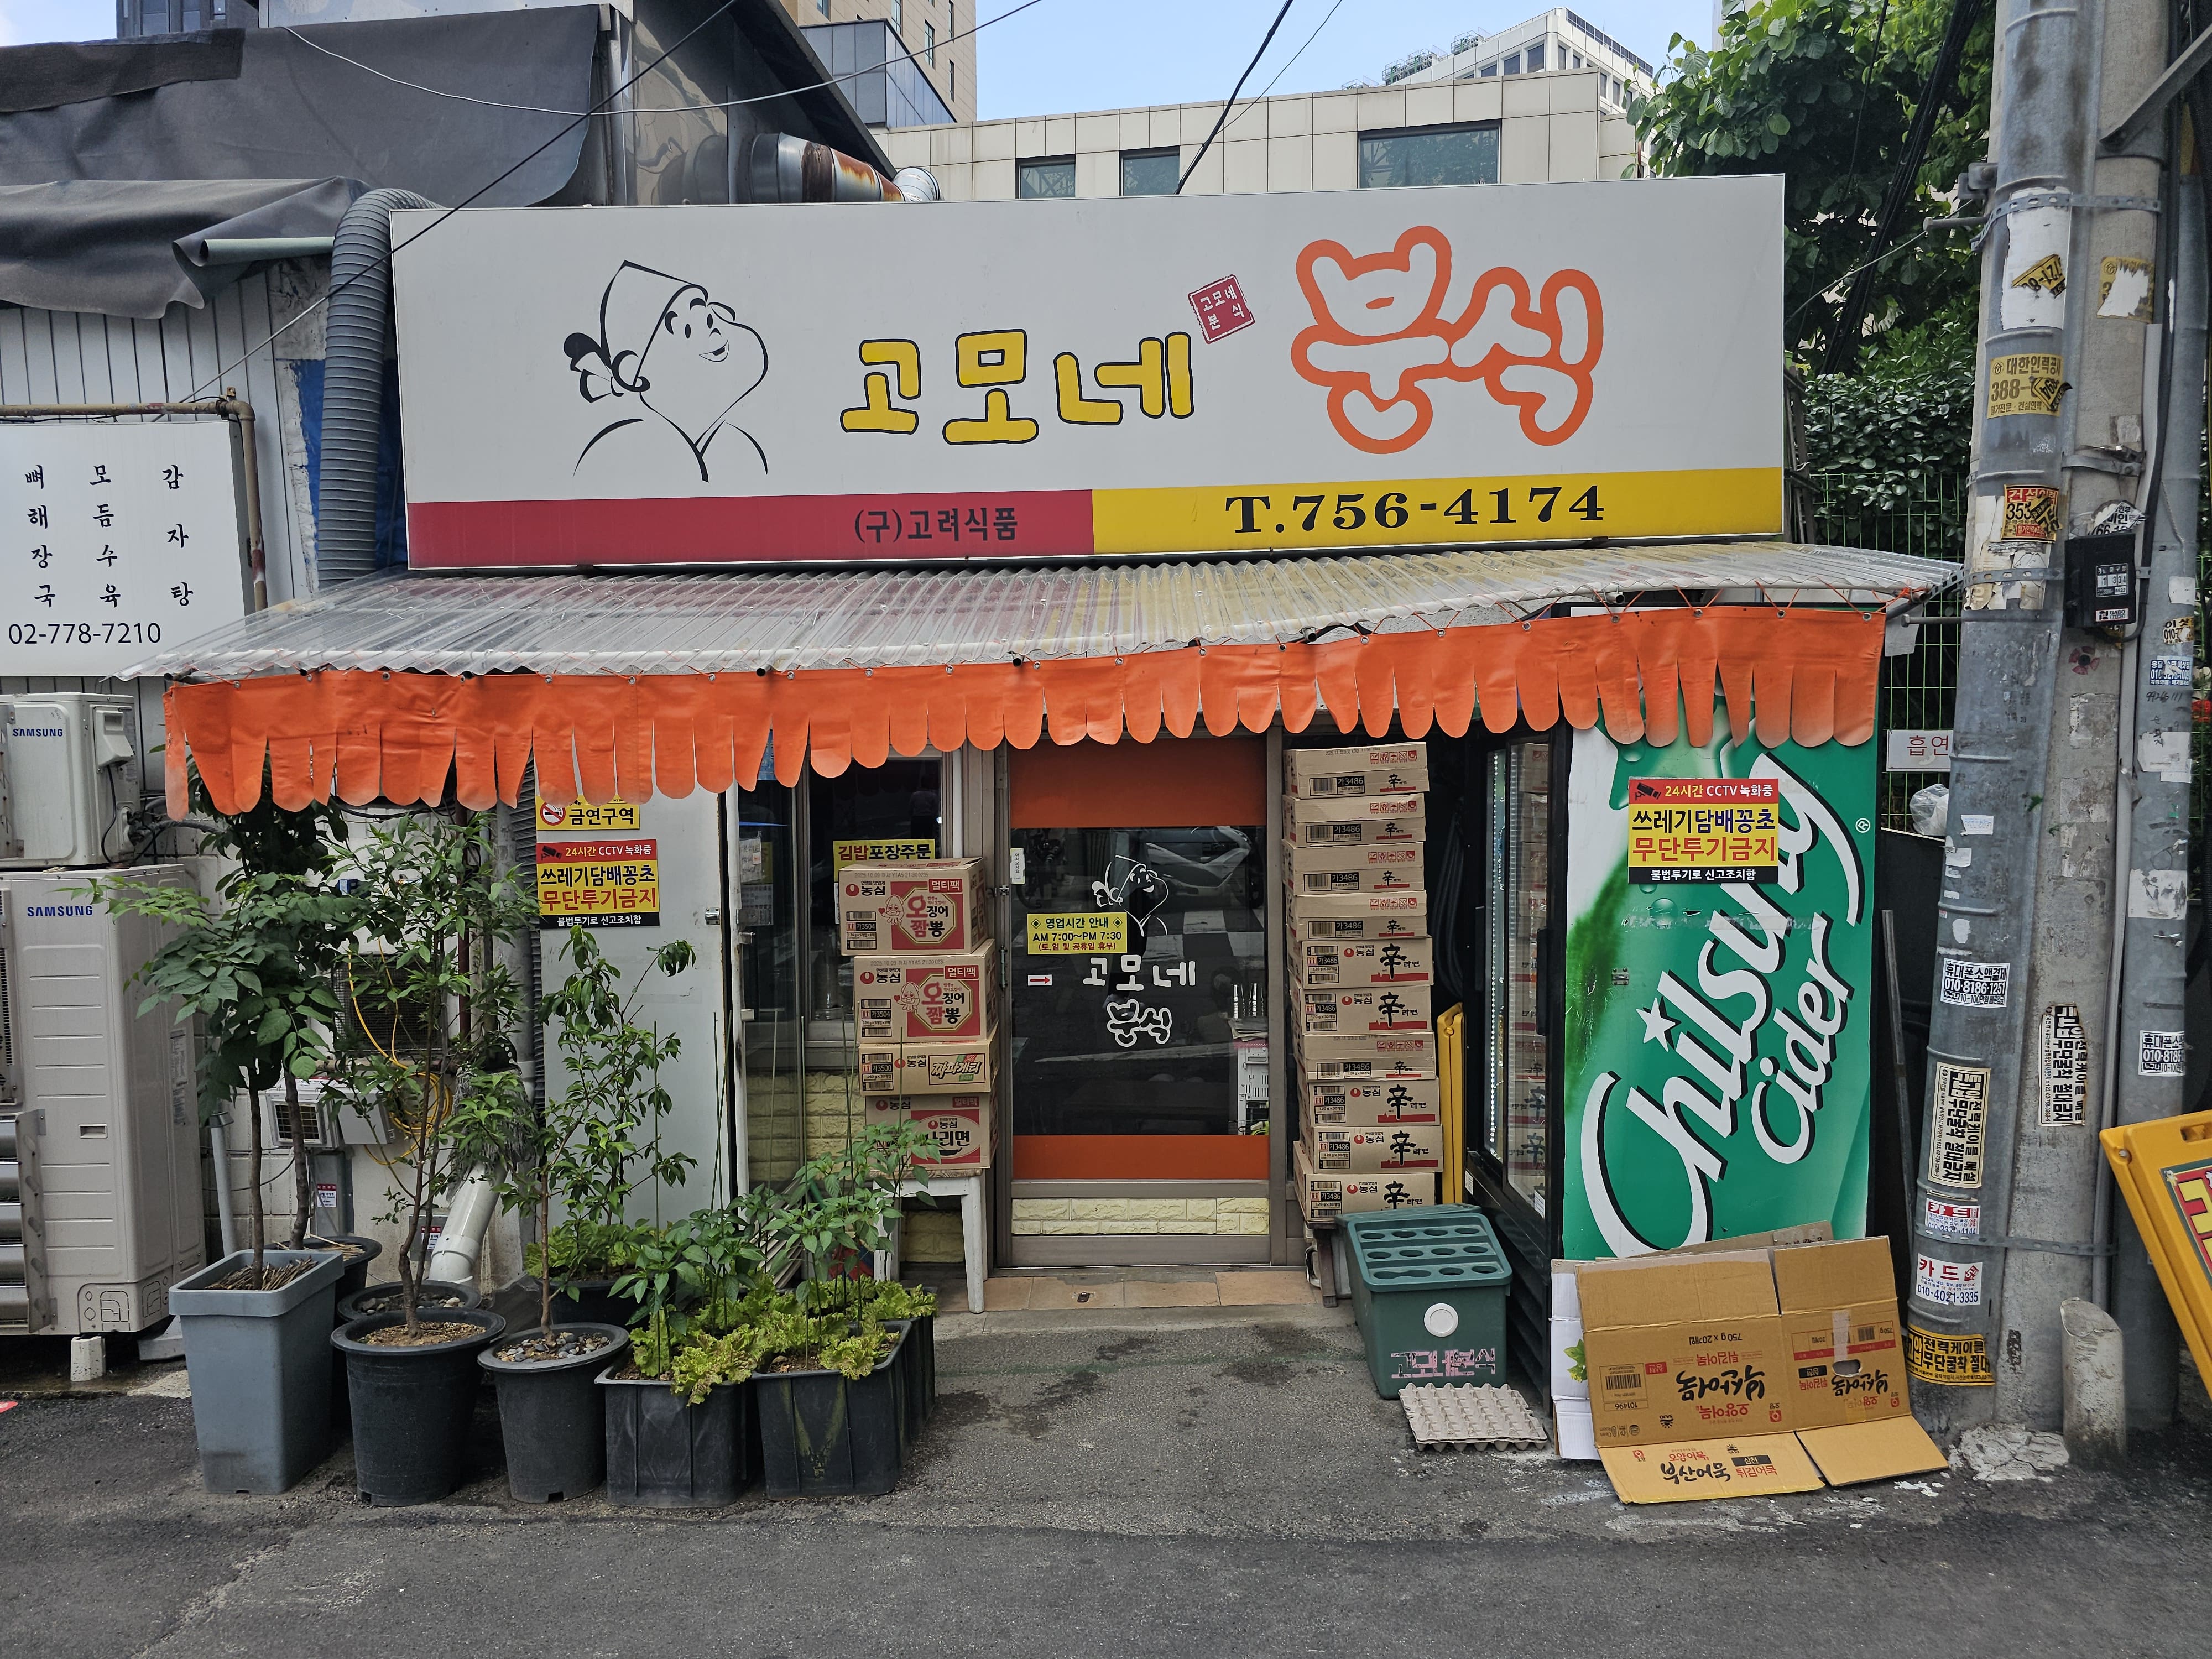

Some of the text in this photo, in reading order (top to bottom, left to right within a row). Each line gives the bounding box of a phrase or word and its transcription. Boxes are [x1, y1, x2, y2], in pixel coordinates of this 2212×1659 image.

[1200, 284, 1237, 311] 고모네
[1291, 225, 1604, 454] 분식
[840, 329, 1195, 445] 고모네
[1225, 485, 1604, 534] T.756-4174
[163, 465, 194, 607] 감자탕
[854, 507, 1018, 544] (구)고려식품
[25, 465, 55, 608] 뼈해장국
[90, 465, 121, 608] 모듬수육
[8, 622, 161, 644] 02-778-7210
[13, 728, 64, 737] SAMSUNG
[1907, 735, 1948, 757] 흡연
[1665, 784, 1773, 798] 24시간 CCTV 녹화중
[568, 807, 634, 825] 금연구역
[1632, 809, 1776, 834] 쓰레기담배꽁초
[565, 844, 652, 857] 24시간 CCTV 녹화중
[1632, 836, 1775, 862] 무단투기금지
[540, 864, 656, 887] 쓰레기담배꽁초
[931, 880, 959, 891] 멀티팩
[1650, 869, 1756, 881] 불법투기로 신고조치함
[542, 888, 656, 911] 무단투기금지
[861, 886, 885, 896] 농심
[27, 905, 93, 917] SAMSUNG
[557, 915, 642, 927] 불법투기로 신고조치함
[910, 920, 945, 938] 짬뽕
[1045, 917, 1108, 929] 영업시간 안내
[1033, 933, 1048, 941] AM
[1100, 931, 1121, 940] 7:30
[1073, 942, 1095, 951] 공휴일
[1098, 942, 1116, 951] 휴무)
[948, 966, 976, 977] 멀티팩
[1380, 943, 1407, 980] 辛
[1945, 963, 2007, 981] 휴대폰소액결제
[876, 973, 901, 983] 농심
[1083, 954, 1196, 992] 고모네
[926, 1006, 961, 1025] 짬뽕
[1378, 992, 1405, 1028] 辛
[1107, 999, 1172, 1047] 분식
[1751, 911, 1854, 1165] Cider
[907, 1059, 927, 1067] 농심
[931, 1061, 982, 1079] 짜파게티
[2053, 1040, 2073, 1121] 무단굴착 절대금지
[889, 1100, 910, 1110] 농심
[1386, 1084, 1414, 1120] 辛
[1945, 1098, 1969, 1139] 무단굴착
[1390, 1130, 1416, 1166] 辛
[1963, 1100, 1983, 1182] 전력케이블 매설
[1942, 1142, 1965, 1182] 절대금지
[1359, 1185, 1378, 1193] 농심
[1384, 1180, 1410, 1209] 辛
[1929, 1202, 1968, 1218] 카드
[1919, 1258, 1959, 1281] 카드
[1689, 1335, 1713, 1345] 20개입
[1728, 1333, 1743, 1342] 750
[1923, 1337, 1984, 1354] 전력케이블
[1696, 1350, 1739, 1366] 튀김어묵
[1923, 1352, 1967, 1373] 무단굴착
[1676, 1365, 1765, 1401] 부산어묵
[1799, 1378, 1828, 1391] 튀김어묵
[1831, 1369, 1888, 1396] 부산어묵
[1699, 1402, 1750, 1420] 오양어묵
[1669, 1451, 1706, 1462] 오양어묵
[1660, 1462, 1731, 1485] 부산어묵
[1735, 1465, 1778, 1478] 튀김어묵
